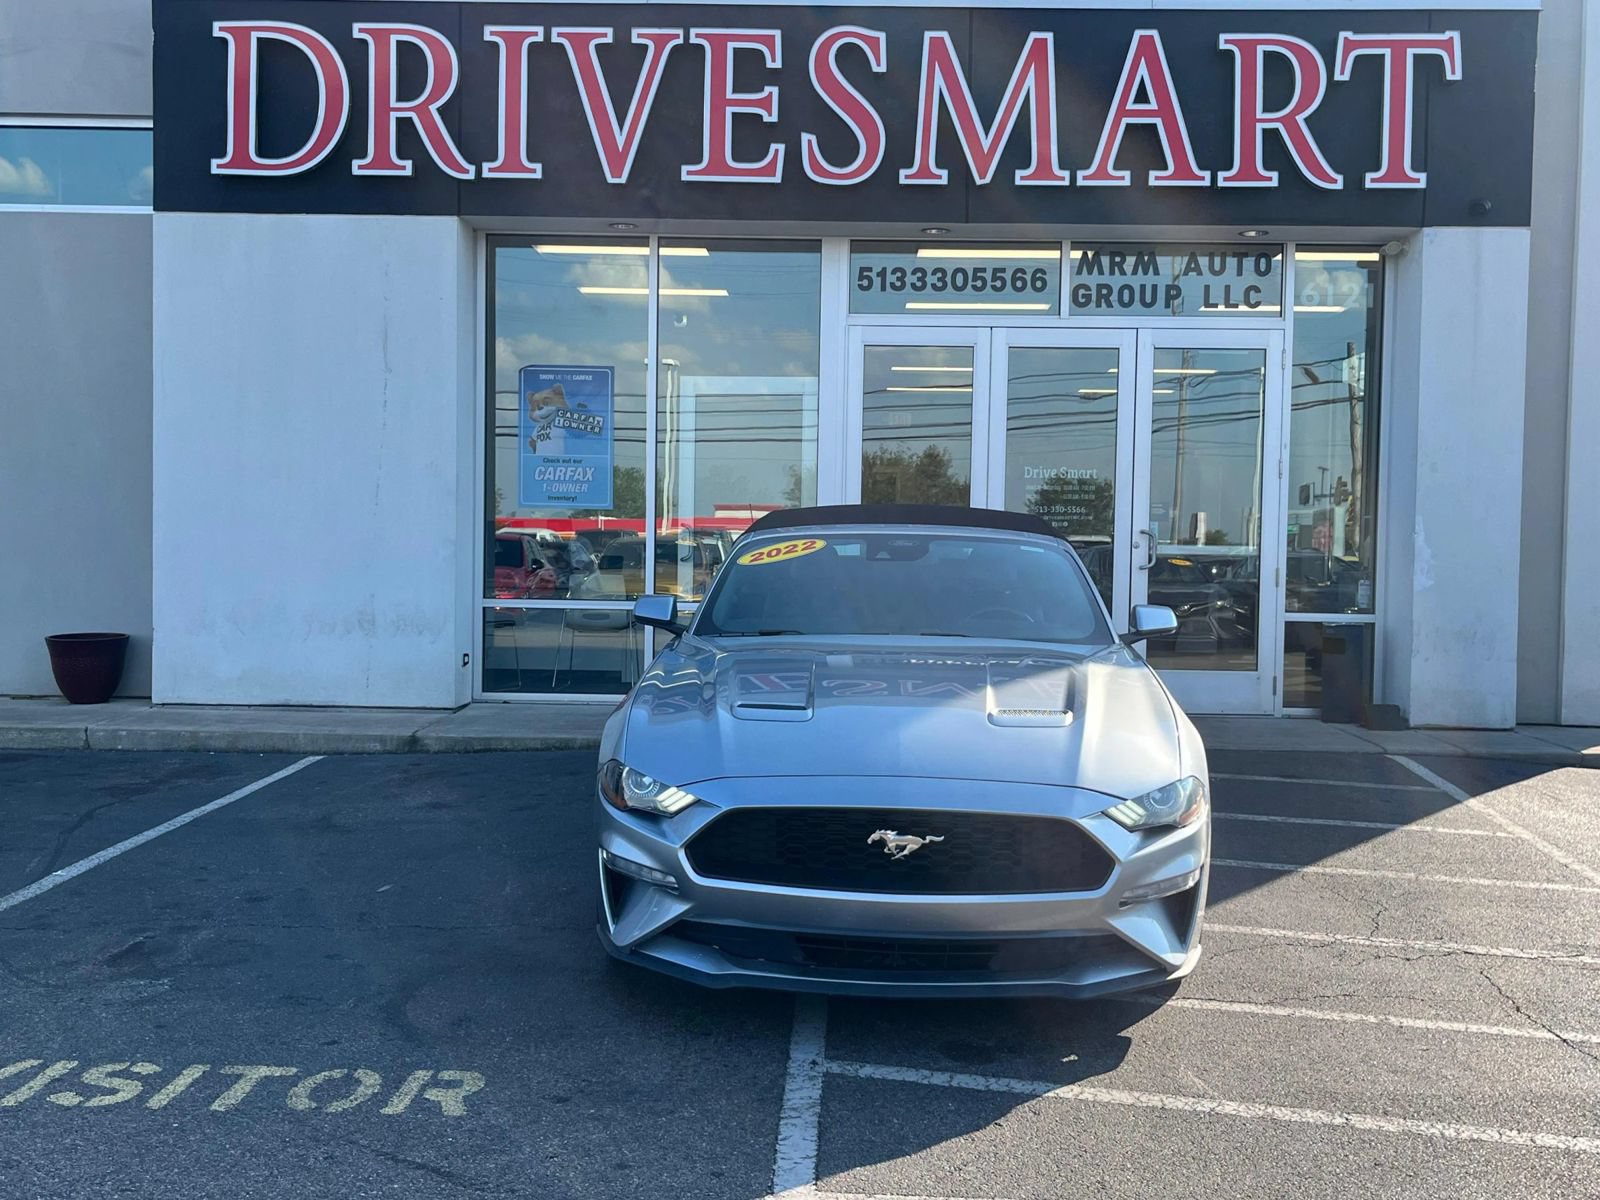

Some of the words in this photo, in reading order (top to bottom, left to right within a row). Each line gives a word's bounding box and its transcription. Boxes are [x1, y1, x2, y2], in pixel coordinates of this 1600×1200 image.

[210, 19, 1463, 190] DRIVESMART
[1075, 250, 1160, 276] MRM
[1182, 251, 1272, 277] AUTO
[857, 266, 1048, 293] 5133305566
[1072, 283, 1183, 309] GROUP
[1203, 284, 1262, 309] LLC
[558, 410, 603, 426] CARFAX
[534, 466, 595, 481] CARFAX
[1024, 466, 1057, 480] Drive
[1059, 466, 1097, 479] Smart
[748, 540, 817, 563] 2022
